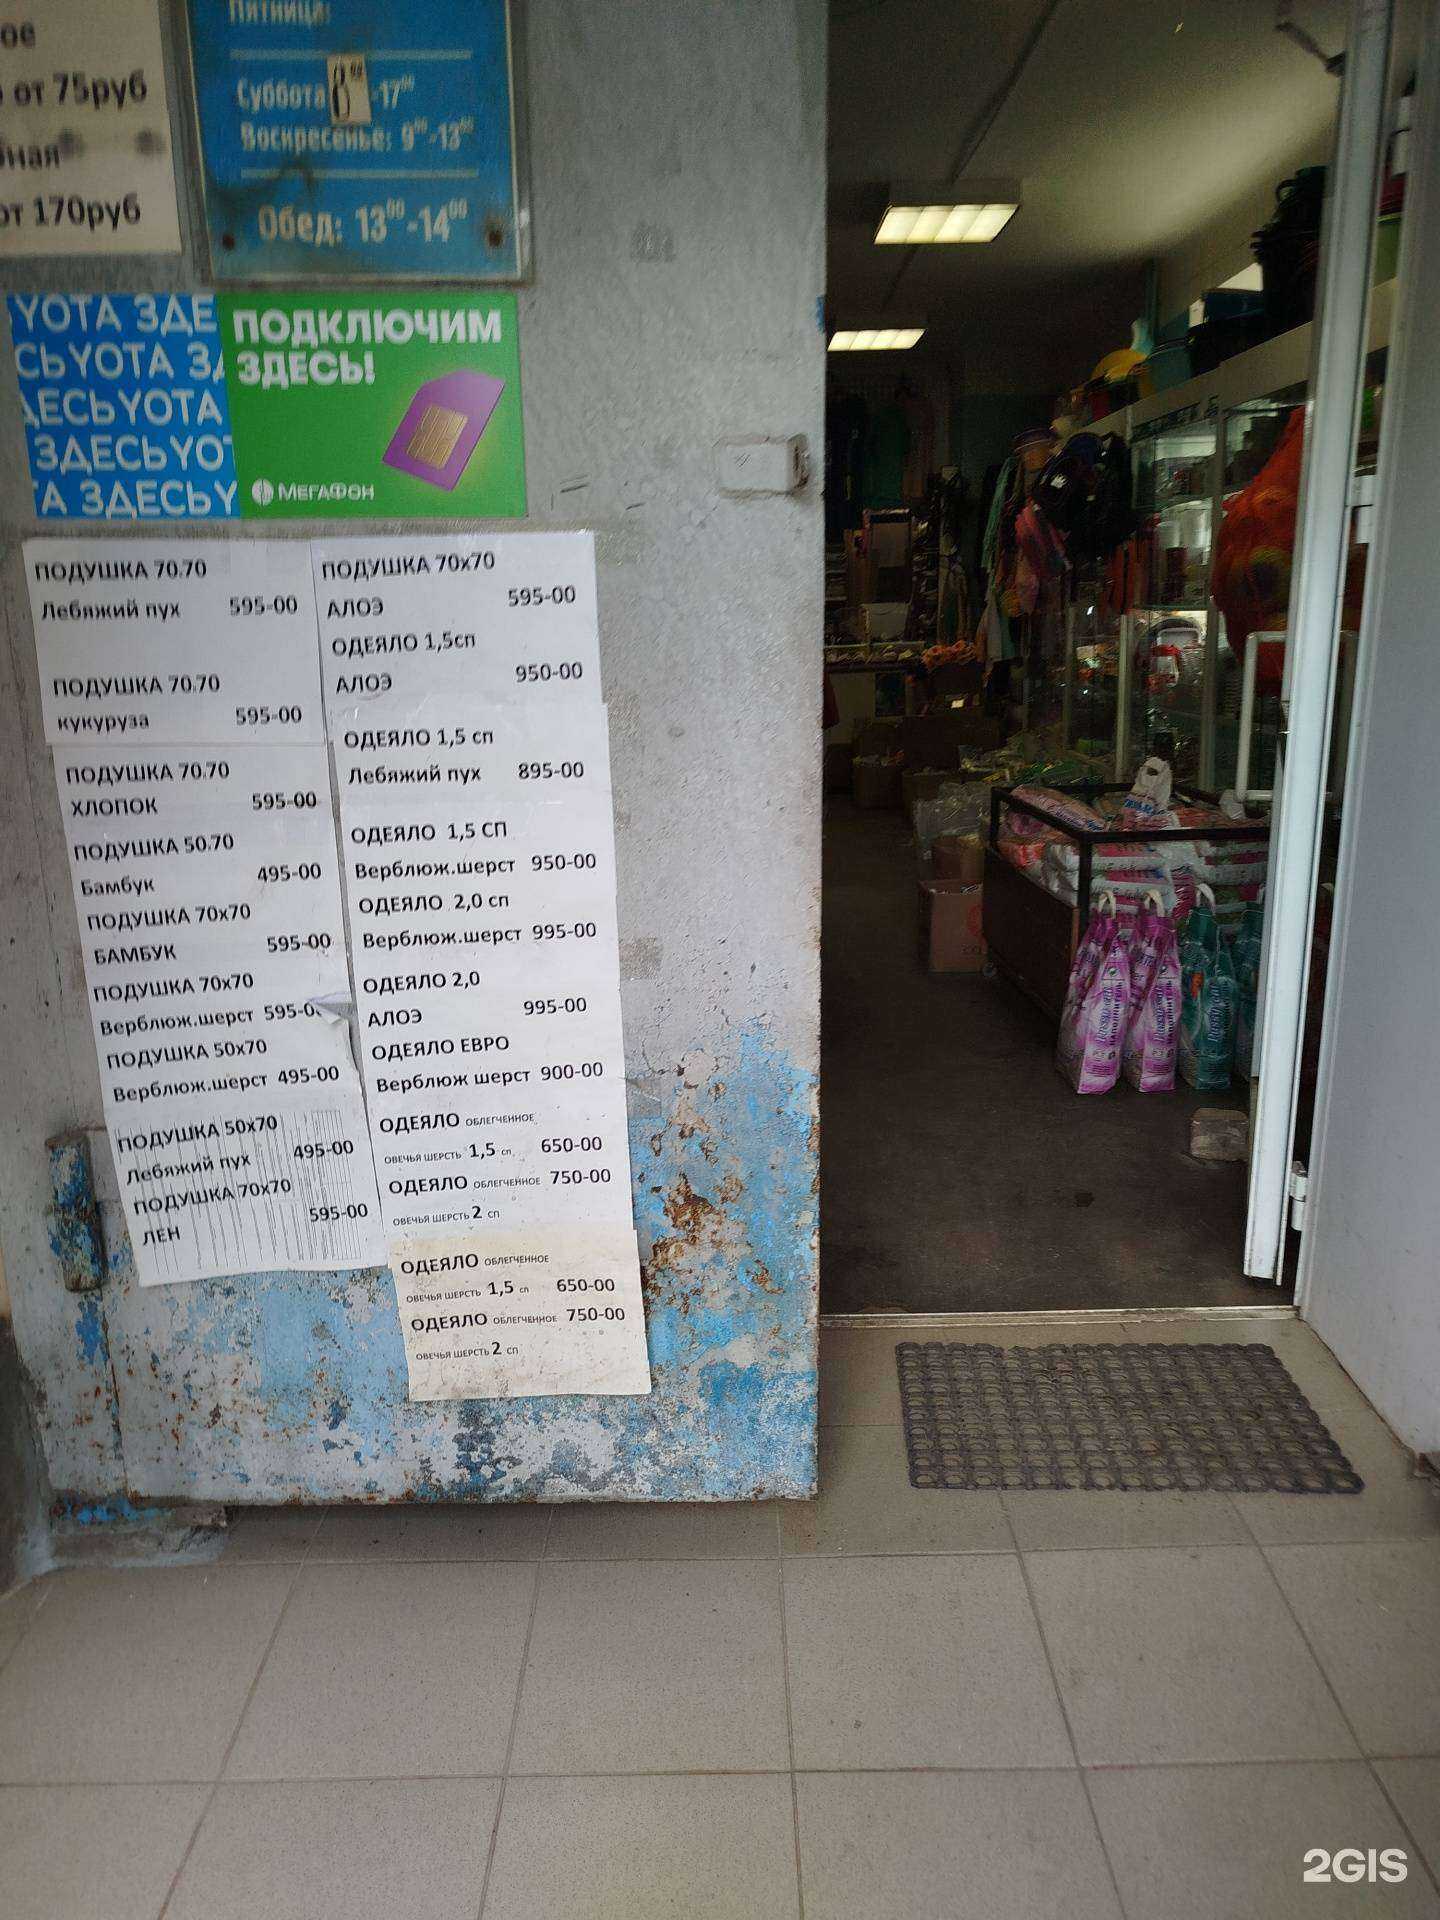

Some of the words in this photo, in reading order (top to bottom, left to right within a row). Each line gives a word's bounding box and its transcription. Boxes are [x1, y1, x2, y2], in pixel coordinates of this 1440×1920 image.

[14, 78, 45, 106] от
[53, 68, 148, 111] 75руб
[34, 191, 141, 232] 170руб
[258, 204, 342, 247] Обед:
[233, 309, 501, 347] ПОДКЛЮЧИМ
[237, 350, 376, 390] ЗДЕСЬ!
[35, 561, 148, 583] ПОДУШКА
[322, 558, 430, 583] ПОДУШКА
[41, 598, 139, 622] Лебяжий
[146, 601, 181, 621] пух
[230, 596, 298, 616] 595-00
[327, 598, 384, 619] АЛОЭ
[508, 586, 576, 607] 595-00
[332, 634, 418, 659] ОДЕЯЛО
[53, 676, 163, 699] ПОДУШКА
[336, 673, 392, 695] АЛОЭ
[516, 662, 583, 683] 950-00
[57, 714, 149, 734] кукуруза
[235, 705, 302, 725] 595-00
[344, 729, 430, 751] ОДЕЯЛО
[437, 728, 466, 748] 1,5
[473, 730, 494, 745] сп
[66, 764, 173, 786] ПОДУШКА
[349, 764, 440, 785] Лебяжий
[447, 767, 481, 785] пух
[518, 762, 584, 779] 895-00
[71, 797, 158, 817] ХЛОПОК
[252, 791, 317, 810] 595-00
[351, 824, 436, 845] ОДЕЯЛО
[448, 823, 476, 842] 1,5
[482, 822, 507, 837] СП
[74, 841, 179, 862] ПОДУШКА
[81, 875, 155, 896] Бамбук
[257, 863, 321, 882] 495-00
[355, 860, 515, 882] Верблюж.шерст
[531, 853, 597, 871] 950-00
[359, 895, 443, 916] ОДЕЯЛО
[454, 893, 483, 911] 2,0
[488, 895, 509, 908] сп
[88, 907, 190, 933] ПОДУШКА
[94, 944, 177, 965] БАМБУК
[267, 932, 331, 953] 595-00
[363, 928, 522, 951] Верблюж.шерст
[532, 922, 597, 940] 995-00
[94, 979, 195, 1003] ПОДУШКА
[363, 973, 447, 995] ОДЕЯЛО
[452, 971, 480, 990] 2,0
[100, 1008, 254, 1038] Верблюж.шерст
[264, 1002, 322, 1021] 595-0
[367, 1009, 422, 1028] АЛОЭ
[523, 997, 587, 1015] 995-00
[107, 1044, 209, 1070] ПОДУШКА
[372, 1039, 455, 1062] ОДЕЯЛО
[461, 1036, 509, 1053] ЕВРО
[113, 1073, 268, 1105] Верблюж.шерст
[278, 1065, 339, 1085] 495-00
[377, 1074, 468, 1095] Верблюж
[474, 1069, 531, 1087] шерст
[541, 1062, 603, 1080] 900-00
[380, 1112, 460, 1134] ОДЕЯЛО
[465, 1113, 535, 1127] ОБЛЕГЧЕННОЕ
[117, 1123, 220, 1154] ПОДУШКА
[469, 1143, 496, 1161] 1,5
[541, 1136, 602, 1153] 650-00
[126, 1157, 214, 1186] Лебяжий
[220, 1153, 250, 1173] пух
[293, 1141, 354, 1161] 495-00
[389, 1175, 468, 1195] ОДЕЯЛО
[473, 1176, 541, 1190] ОБЛЕГЧЕННОЕ
[550, 1169, 611, 1185] 750-00
[134, 1187, 234, 1216] ПОДУШКА
[142, 1226, 181, 1245] ЛЕН
[309, 1204, 369, 1223] 595-00
[393, 1215, 430, 1227] ОВЕЧЬЯ
[433, 1212, 470, 1224] ШЕРСТЬ
[472, 1205, 482, 1220] 2
[487, 1209, 500, 1219] сп
[401, 1253, 479, 1276] ОДЕЯЛО
[484, 1255, 549, 1267] ОБЛЕГЧЕННОЕ
[406, 1293, 442, 1303] ОВЕЧЬЯ
[444, 1289, 481, 1301] ШЕРСТЬ
[487, 1280, 514, 1298] 1,5
[557, 1278, 615, 1292] 650-00
[411, 1313, 487, 1333] ОДЕЯЛО
[493, 1314, 557, 1325] ОБЛЕГЧЕННОЕ
[566, 1307, 625, 1322] 750-00
[416, 1351, 452, 1360] ОВЕЧЬЯ
[454, 1348, 490, 1358] ШЕРСТЬ
[491, 1342, 501, 1355] 2
[506, 1347, 519, 1355] сп
